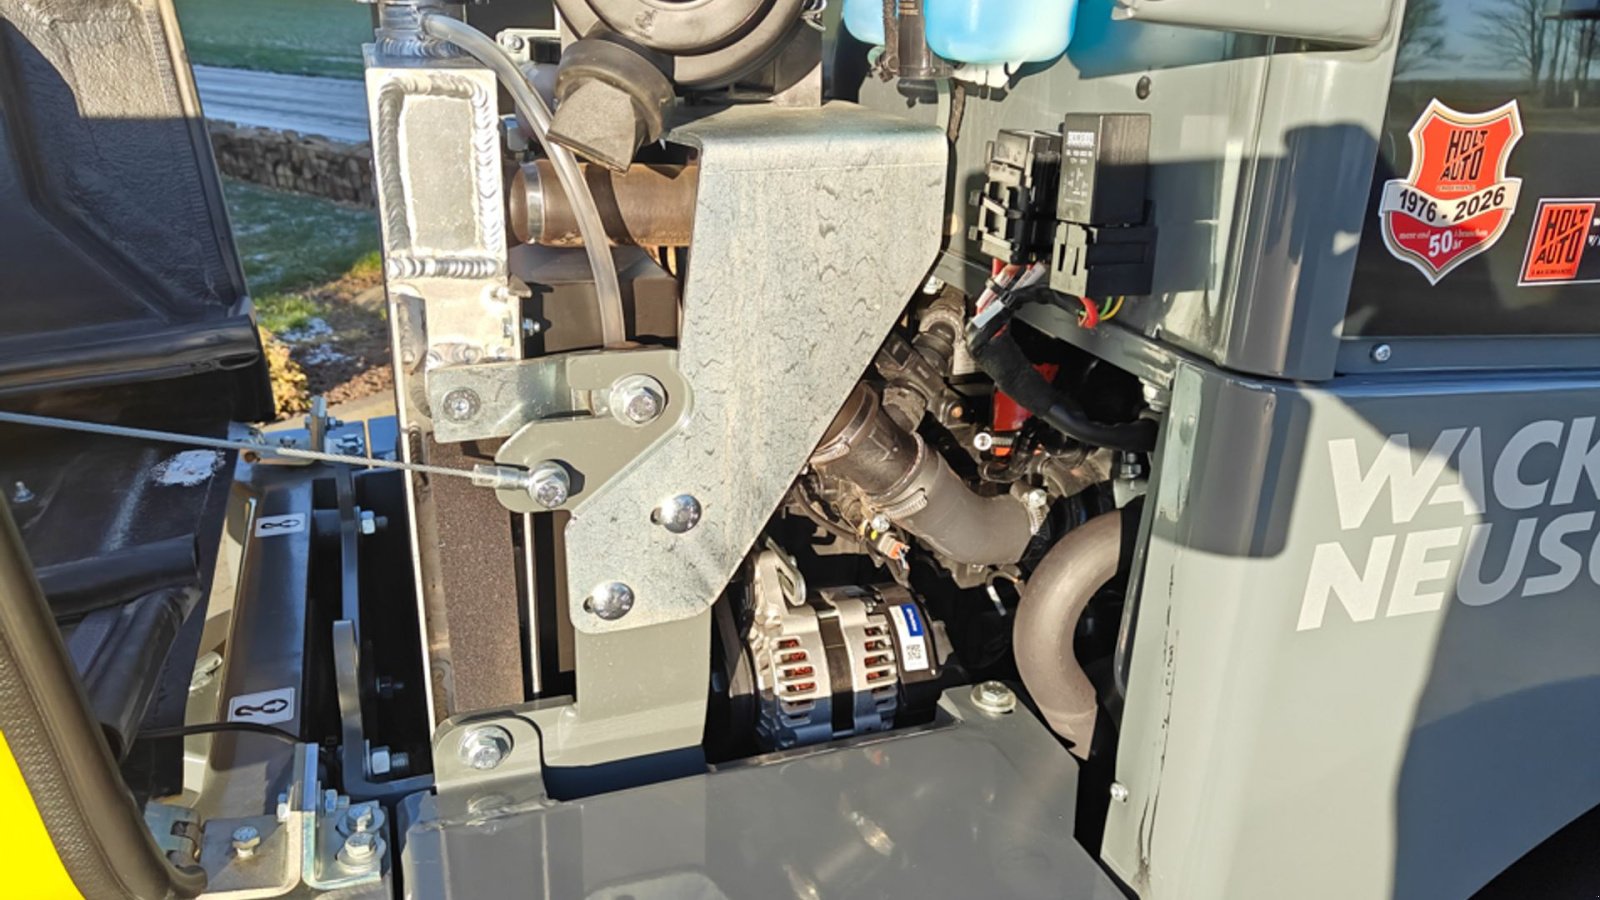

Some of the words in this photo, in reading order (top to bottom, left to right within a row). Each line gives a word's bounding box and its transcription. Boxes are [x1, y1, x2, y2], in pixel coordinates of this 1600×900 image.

[1440, 145, 1485, 180] AUTO
[1445, 130, 1488, 164] HOLT
[1399, 188, 1438, 223] 1976
[1453, 186, 1506, 222] 2026
[1428, 230, 1453, 258] 50
[1534, 226, 1583, 265] AUTO
[1541, 209, 1589, 247] HOLT
[1296, 510, 1600, 632] NEUS
